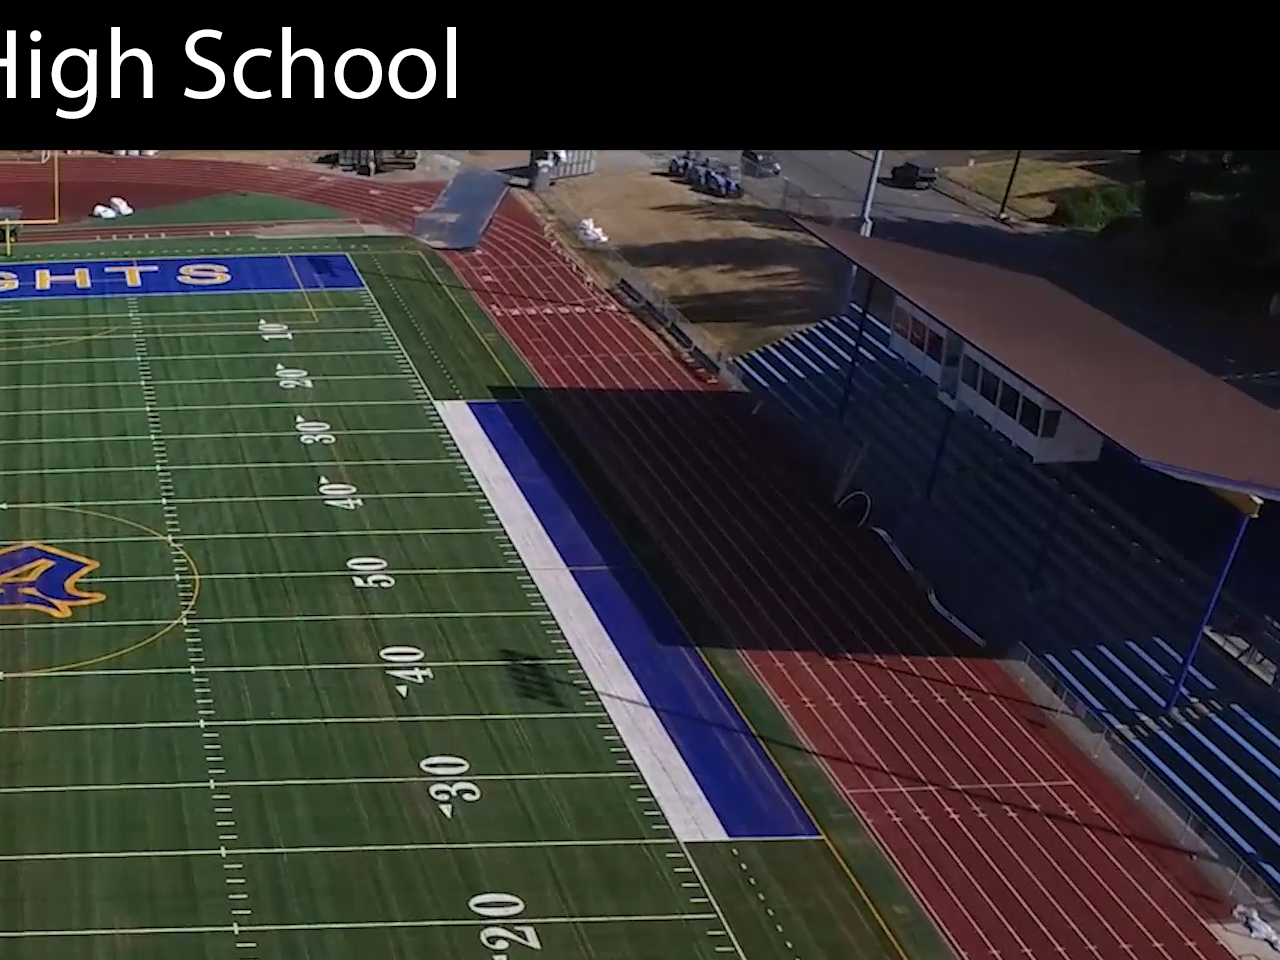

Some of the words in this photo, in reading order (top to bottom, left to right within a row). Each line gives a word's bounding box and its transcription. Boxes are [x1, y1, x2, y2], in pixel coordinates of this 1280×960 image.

[258, 323, 293, 341] 10
[275, 368, 313, 389] 20
[295, 421, 336, 444] 30
[318, 483, 364, 509] 40
[346, 557, 395, 588] 50
[378, 645, 434, 684] 40
[420, 755, 482, 802] 30
[468, 893, 542, 950] 20
